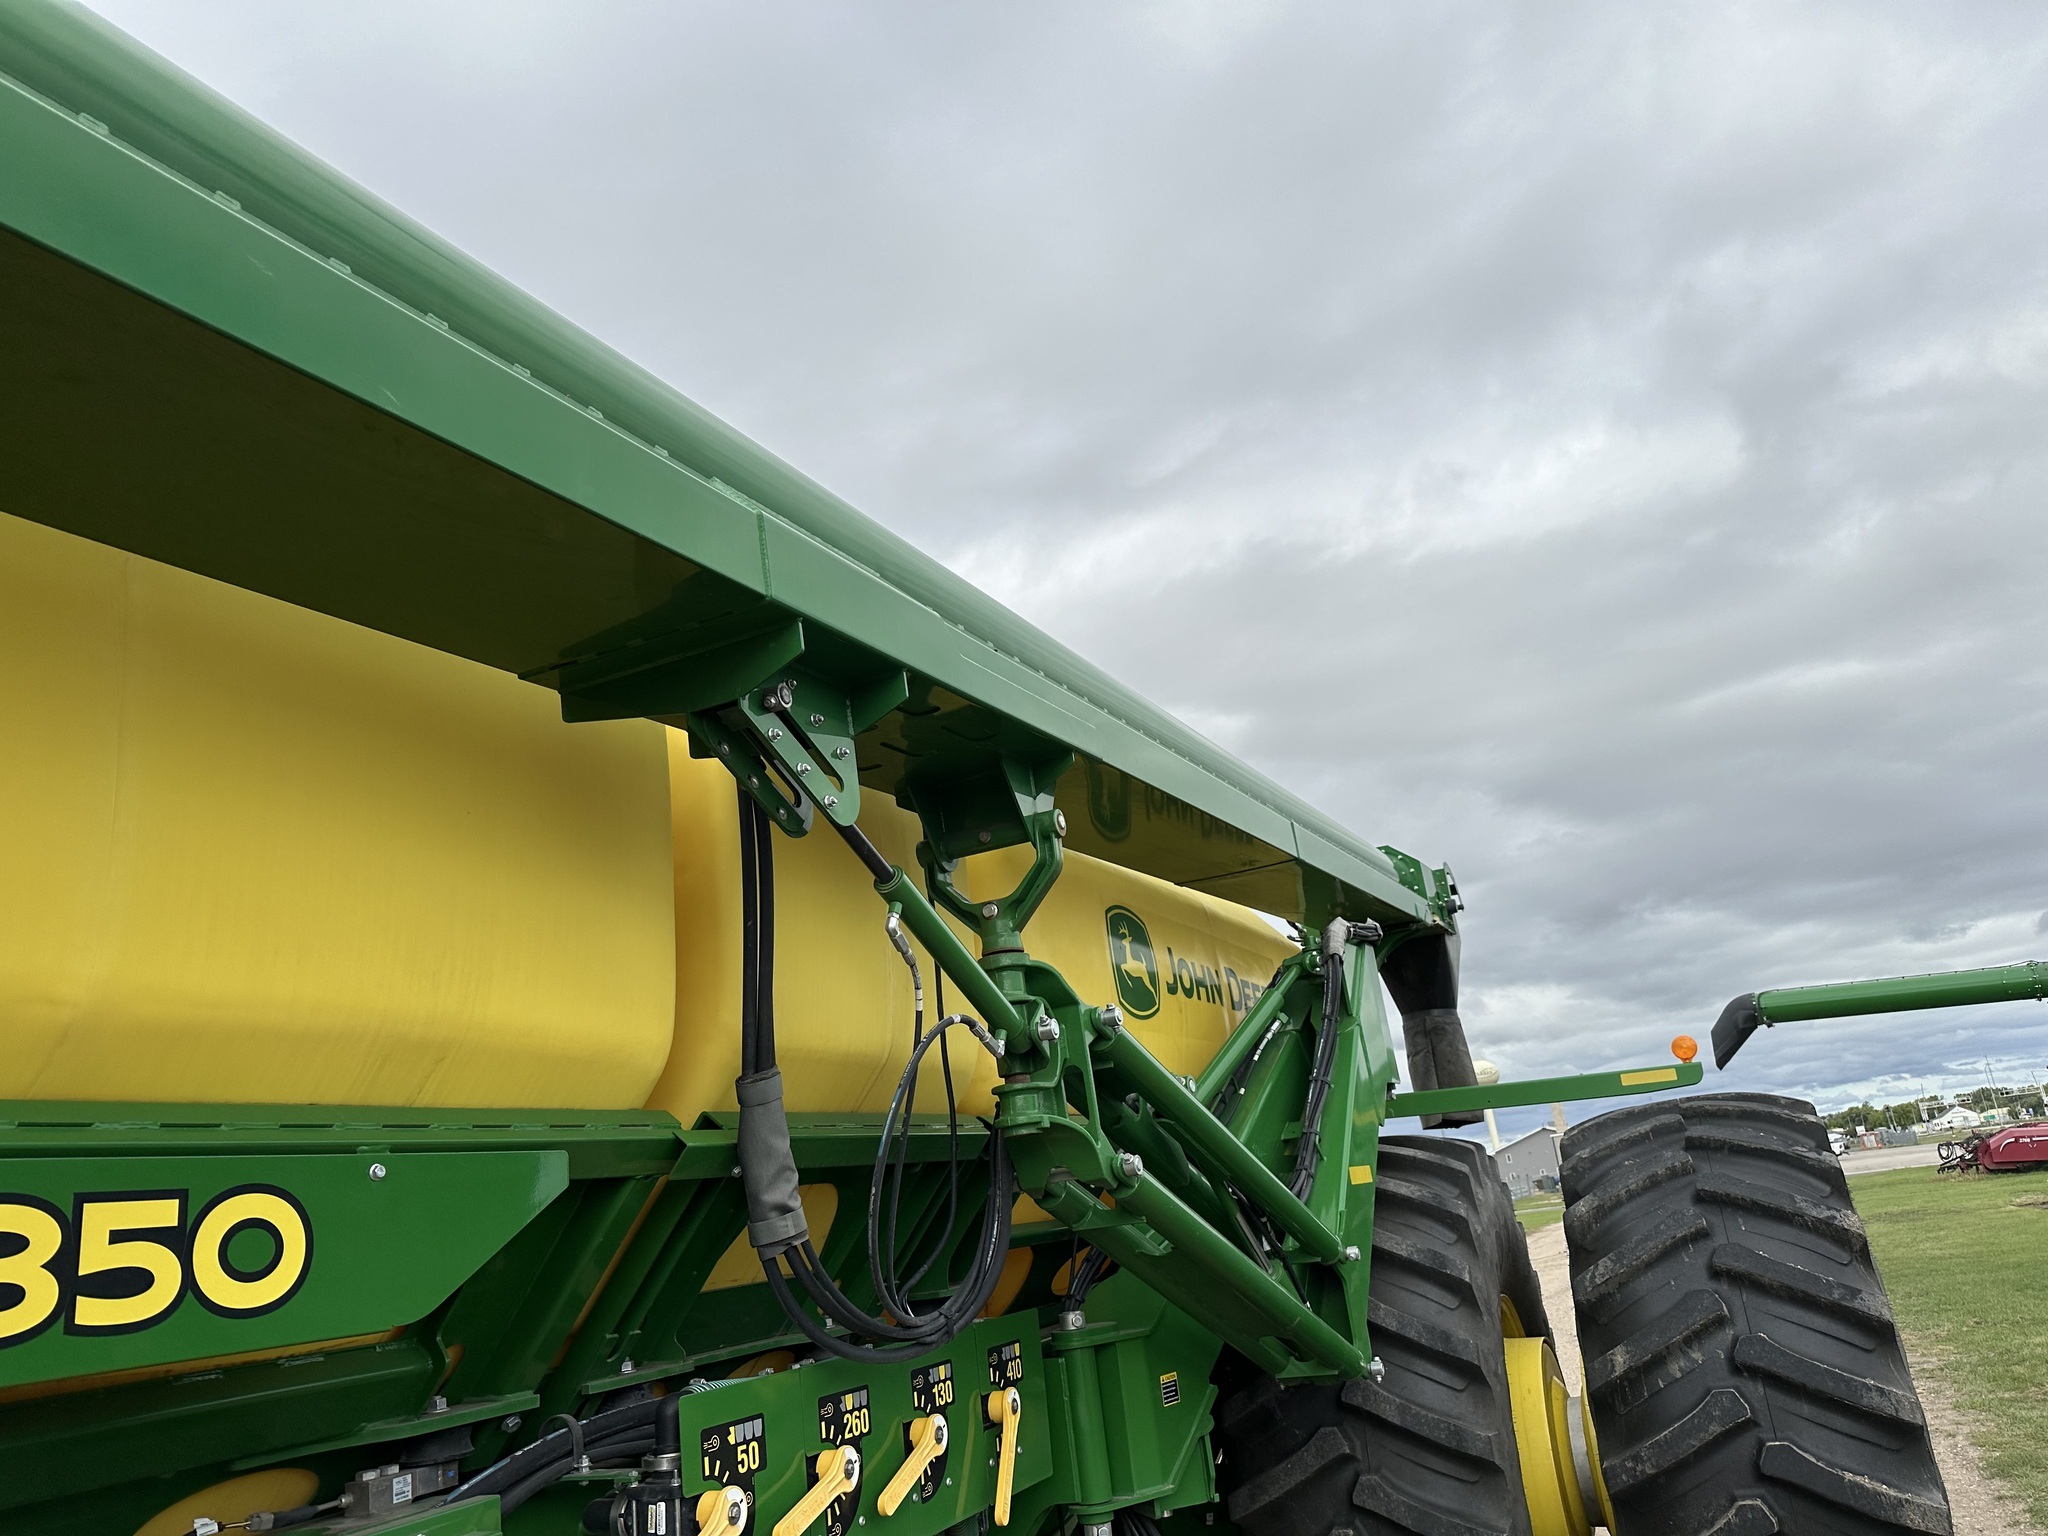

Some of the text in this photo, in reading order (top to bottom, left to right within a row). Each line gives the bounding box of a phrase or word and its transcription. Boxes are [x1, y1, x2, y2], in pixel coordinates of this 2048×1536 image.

[1166, 946, 1266, 1014] JOHN DEE
[1006, 1358, 1022, 1381] 410
[932, 1380, 953, 1407] 130
[843, 1408, 870, 1440] 260
[737, 1441, 760, 1474] 50
